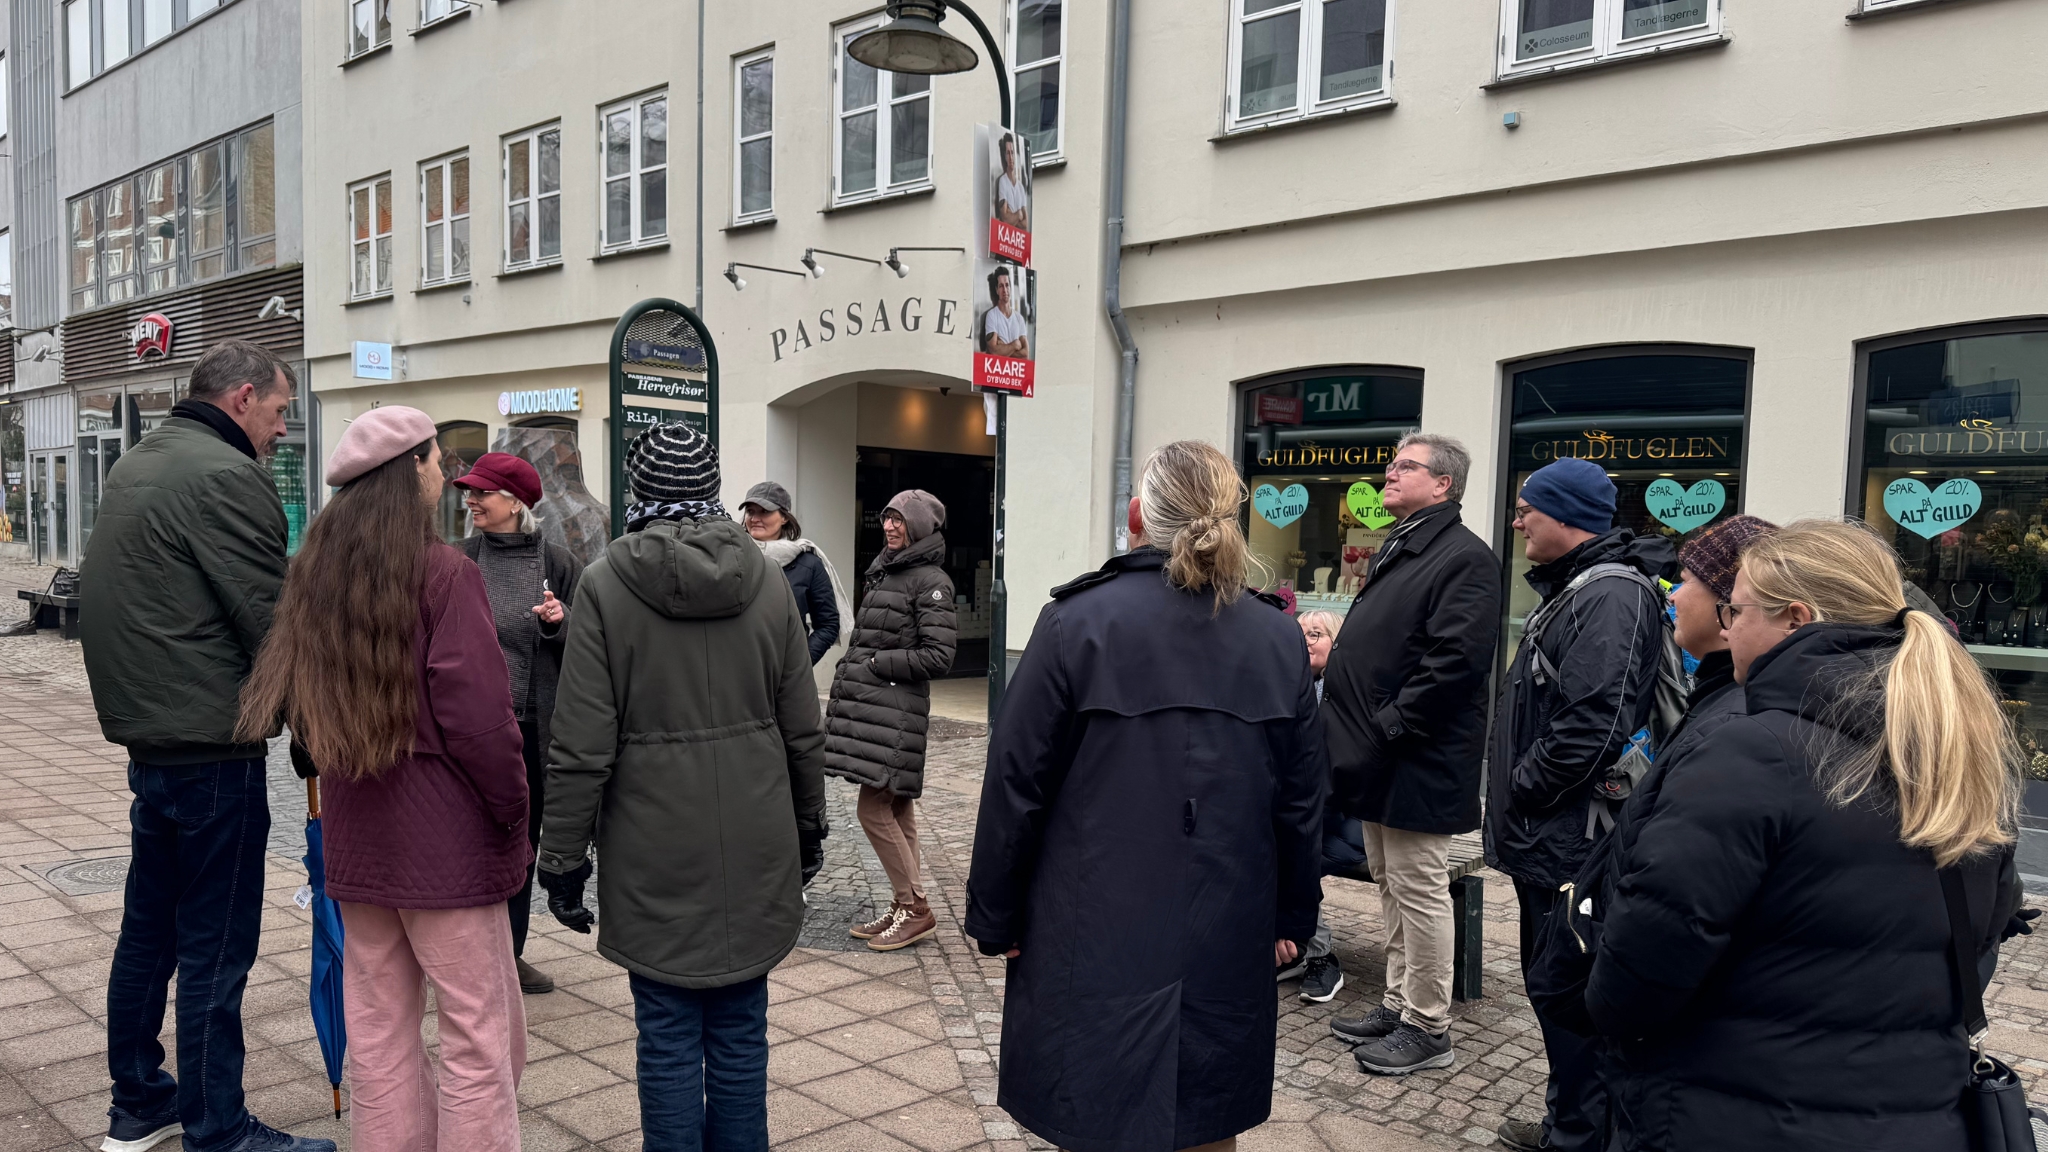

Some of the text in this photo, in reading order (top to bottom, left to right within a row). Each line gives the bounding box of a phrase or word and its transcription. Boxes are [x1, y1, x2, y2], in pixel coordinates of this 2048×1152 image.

[1539, 30, 1590, 48] Colosseum
[997, 224, 1026, 250] KAARE
[1015, 248, 1023, 259] BEK
[131, 321, 163, 347] MENY
[769, 297, 973, 363] PASSAGE
[653, 349, 680, 360] Passagen
[984, 357, 1026, 378] KAARE
[637, 379, 704, 396] Herrefrisør
[986, 375, 1022, 387] DYBVAD BEK
[1025, 384, 1033, 396] A
[626, 411, 658, 424] RiLa
[1531, 436, 1730, 460] GULDFUGLEN
[1889, 430, 2048, 456] GULDFU
[1256, 487, 1272, 498] SPAR
[1351, 487, 1368, 496] SPAR
[1649, 485, 1673, 496] SPAR
[1888, 482, 1917, 495] SPAR
[1264, 504, 1304, 520] ALT GULD
[1355, 507, 1372, 518] ALT
[1659, 503, 1716, 519] ALT GULD
[1899, 503, 1973, 523] ALT GULD
